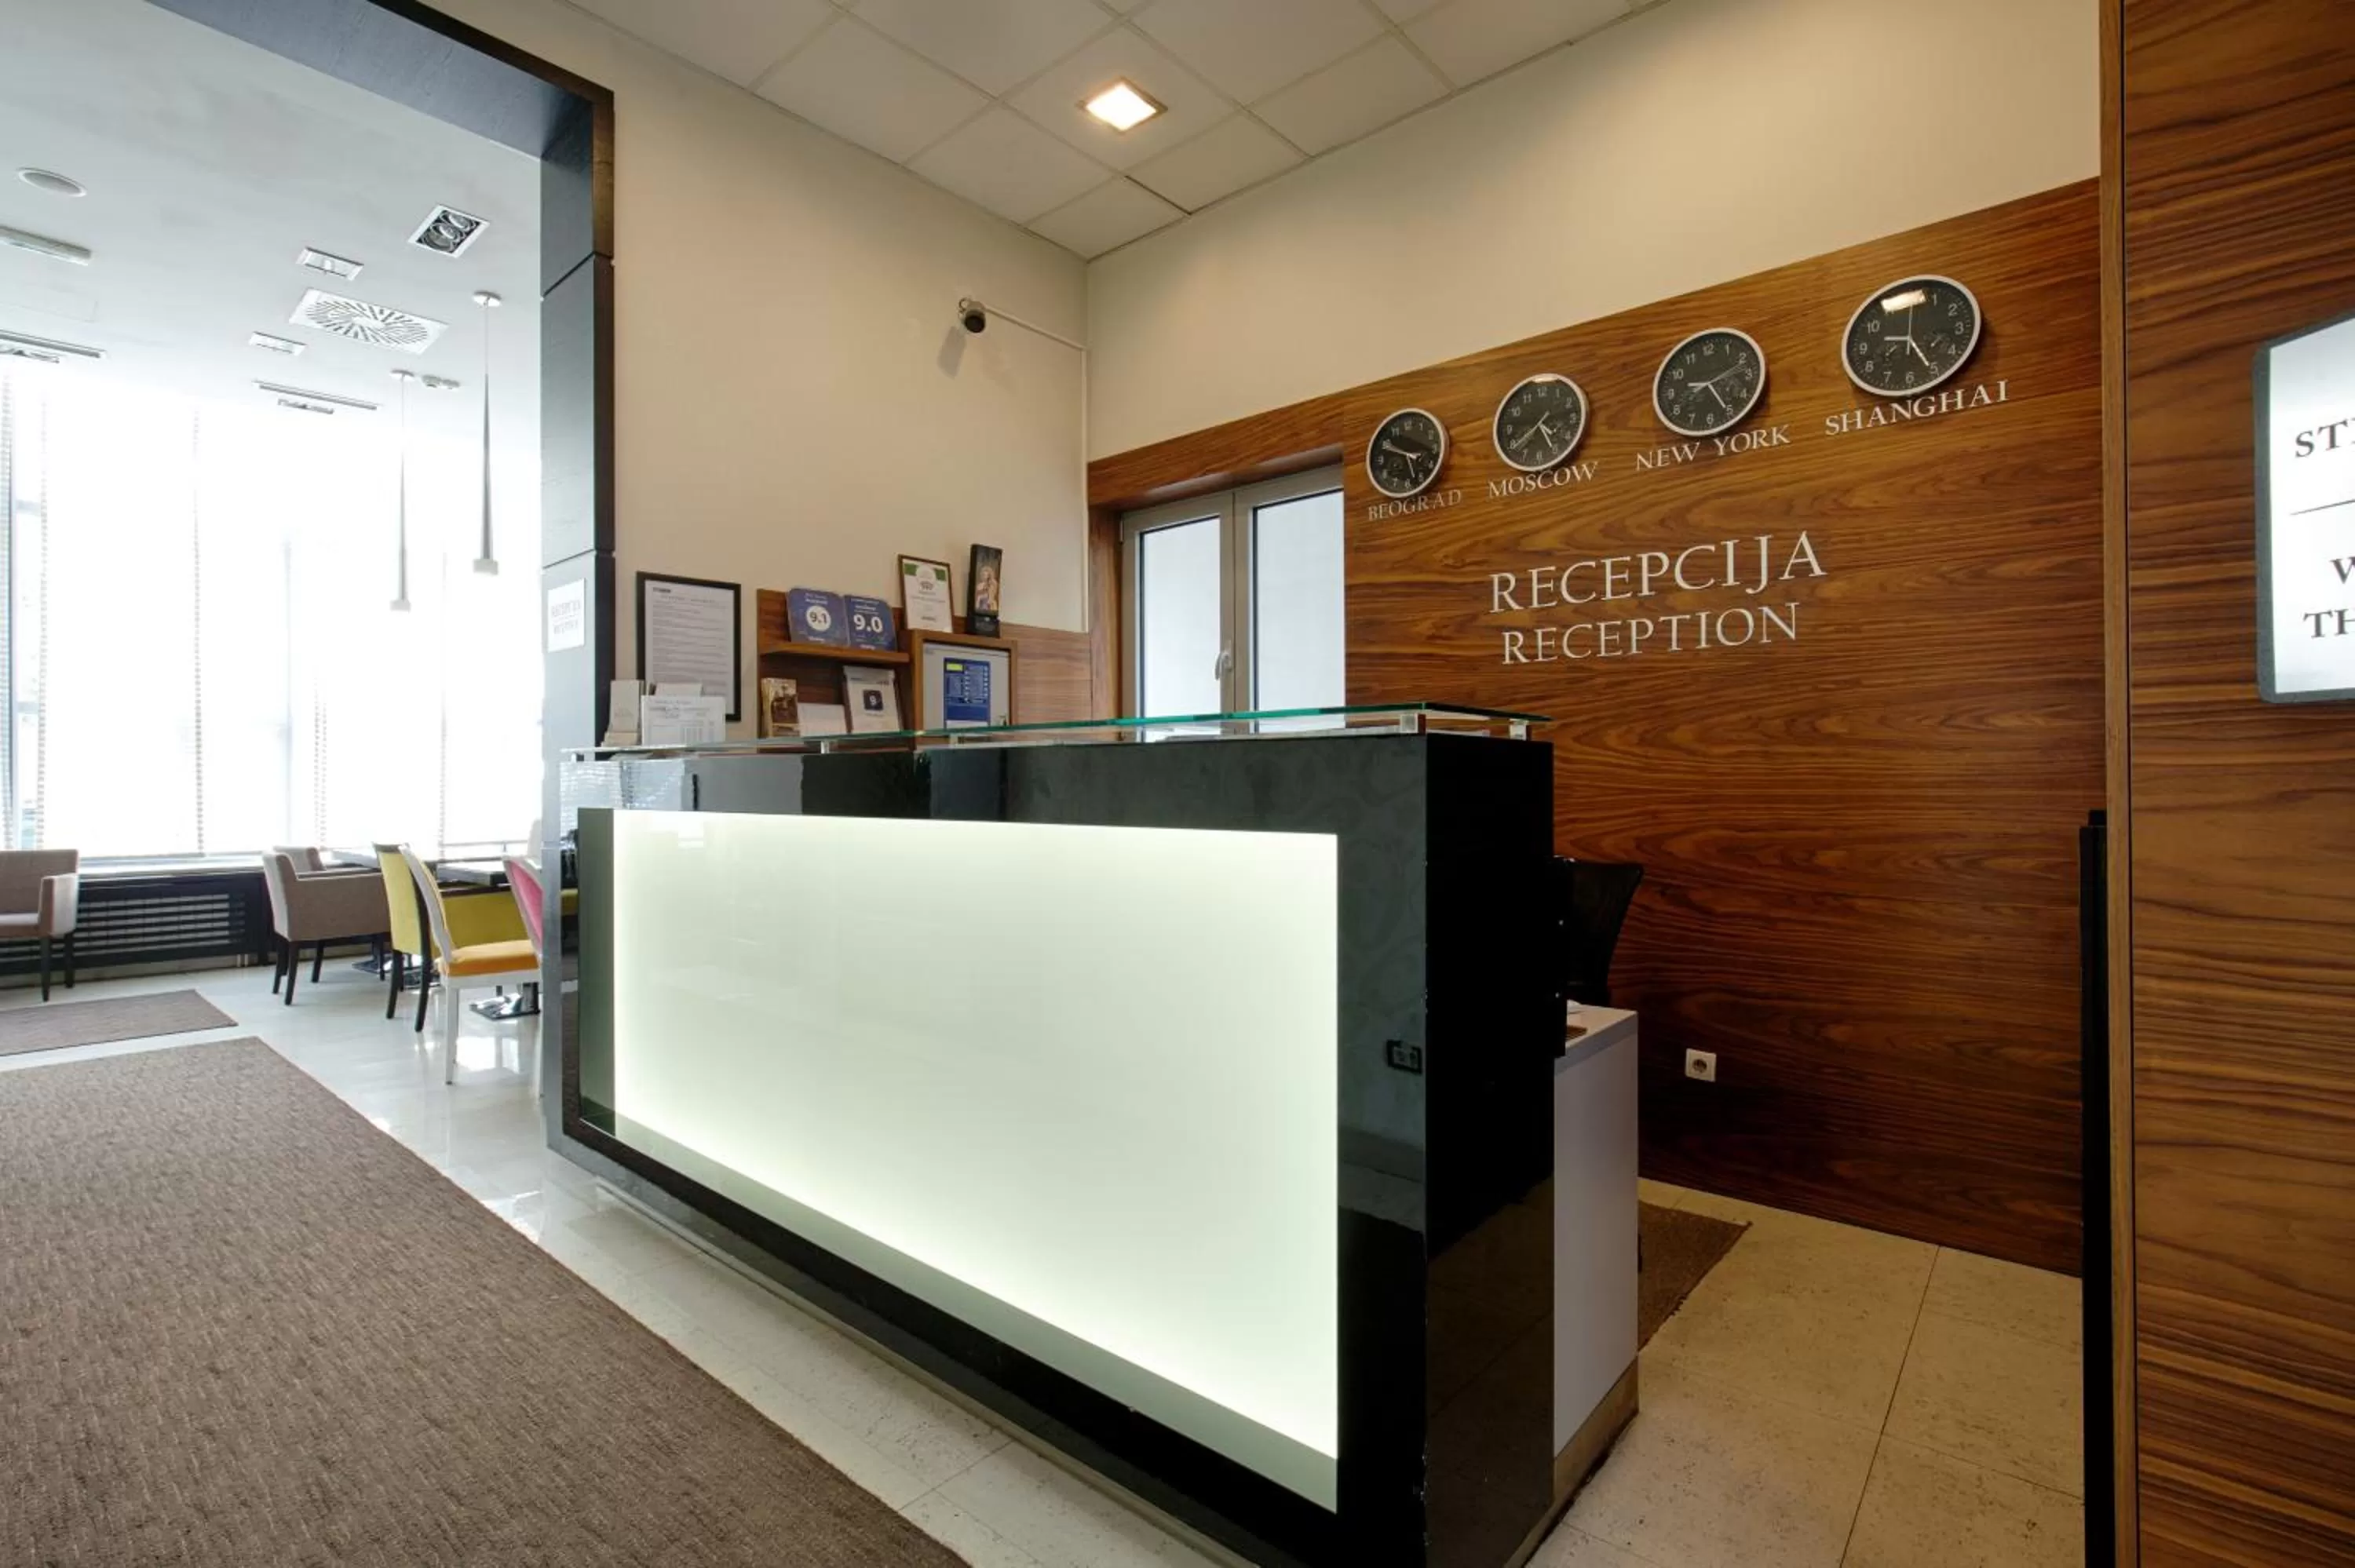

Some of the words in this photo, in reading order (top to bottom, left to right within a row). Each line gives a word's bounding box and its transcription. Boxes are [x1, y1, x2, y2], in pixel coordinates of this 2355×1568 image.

[1948, 304, 1958, 316] 2
[1867, 320, 1880, 333] 10
[1955, 322, 1964, 334] 3
[1860, 343, 1868, 355] 9
[1948, 345, 1956, 355] 4
[1865, 361, 1874, 372] 8
[1930, 363, 1938, 373] 5
[1673, 369, 1683, 380] 10
[1884, 372, 1892, 383] 7
[1906, 372, 1914, 383] 6
[1824, 380, 2010, 436] SHANGHAI
[2294, 417, 2355, 458] ST
[1635, 441, 1701, 471] NEW
[1713, 424, 1791, 456] YORK
[1488, 461, 1599, 498] MOSCOW
[1368, 489, 1461, 521] BEOGRAD
[1489, 531, 1827, 613] RECEPCIJA
[809, 612, 828, 625] 9.1
[853, 614, 883, 633] 9.0
[1502, 602, 1800, 665] RECEPTION
